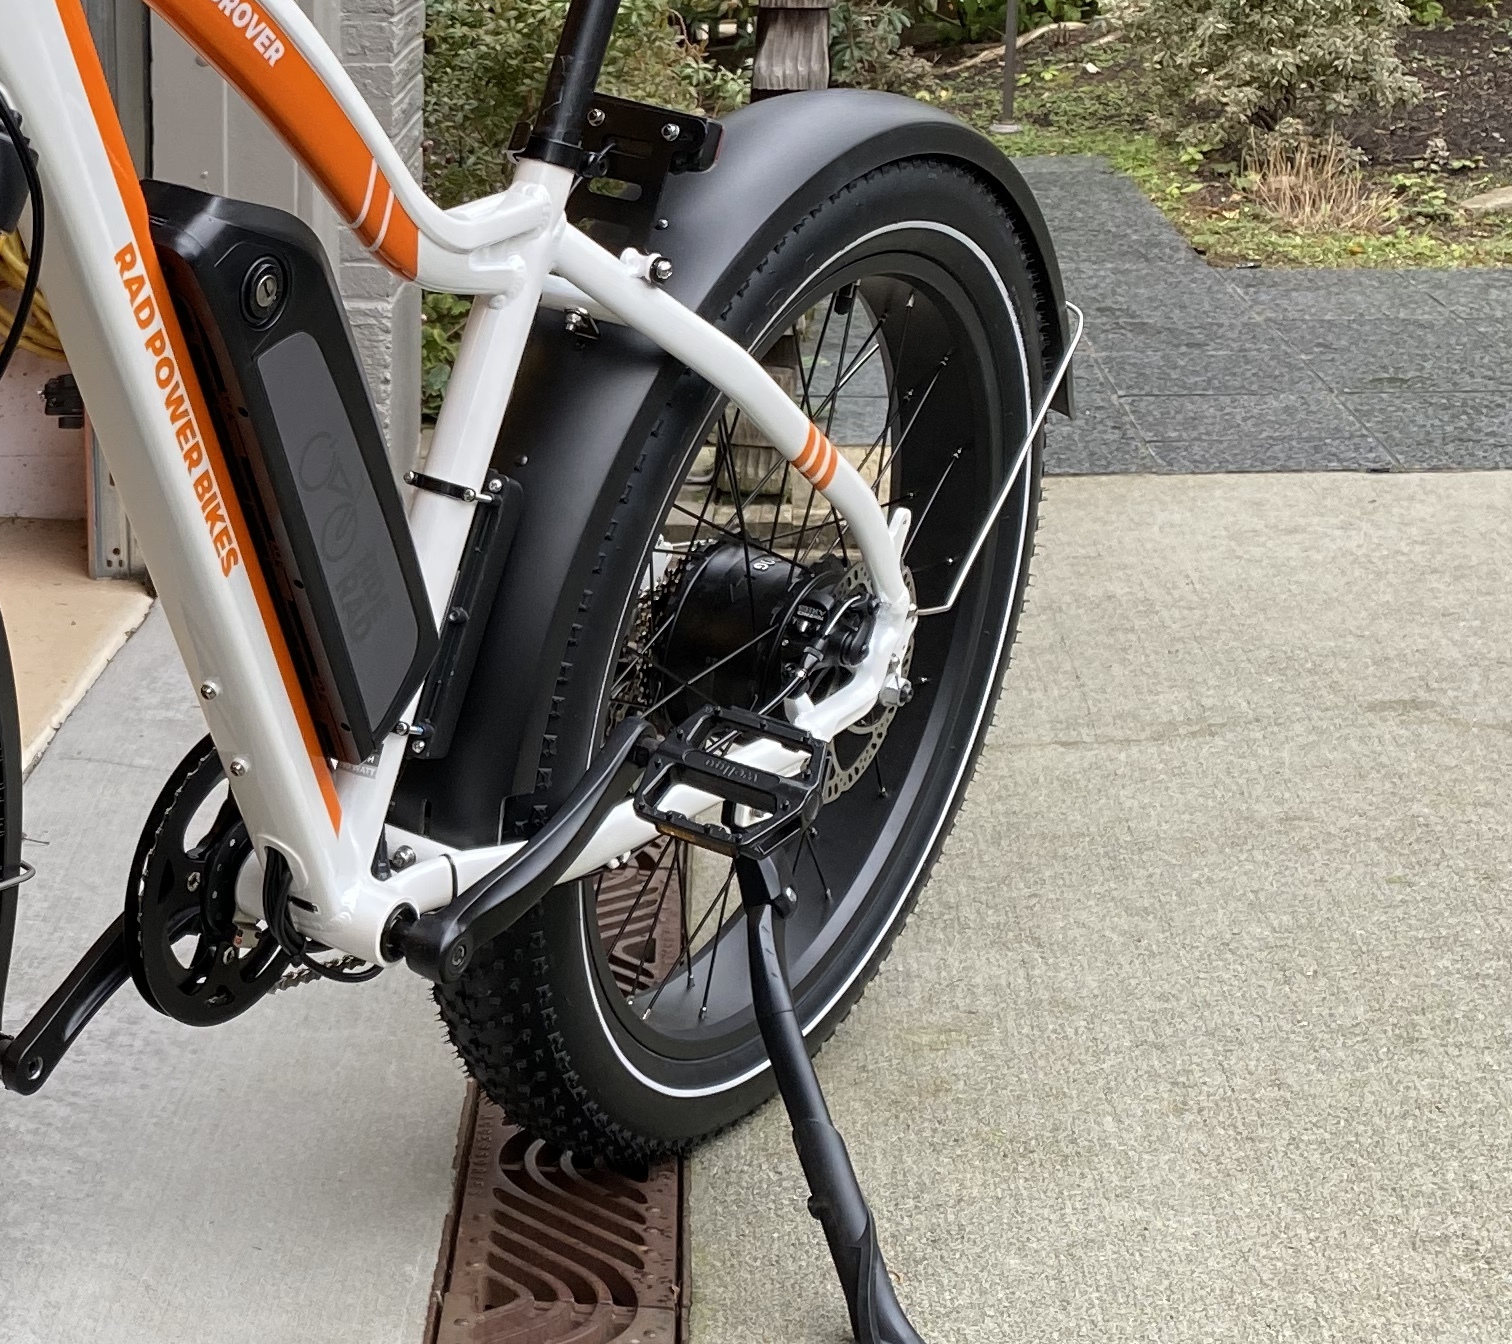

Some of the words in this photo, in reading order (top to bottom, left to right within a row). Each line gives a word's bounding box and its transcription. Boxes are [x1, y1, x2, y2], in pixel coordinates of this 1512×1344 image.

[114, 242, 158, 331] RAD
[144, 327, 203, 477] POWER
[192, 473, 239, 578] BIKES
